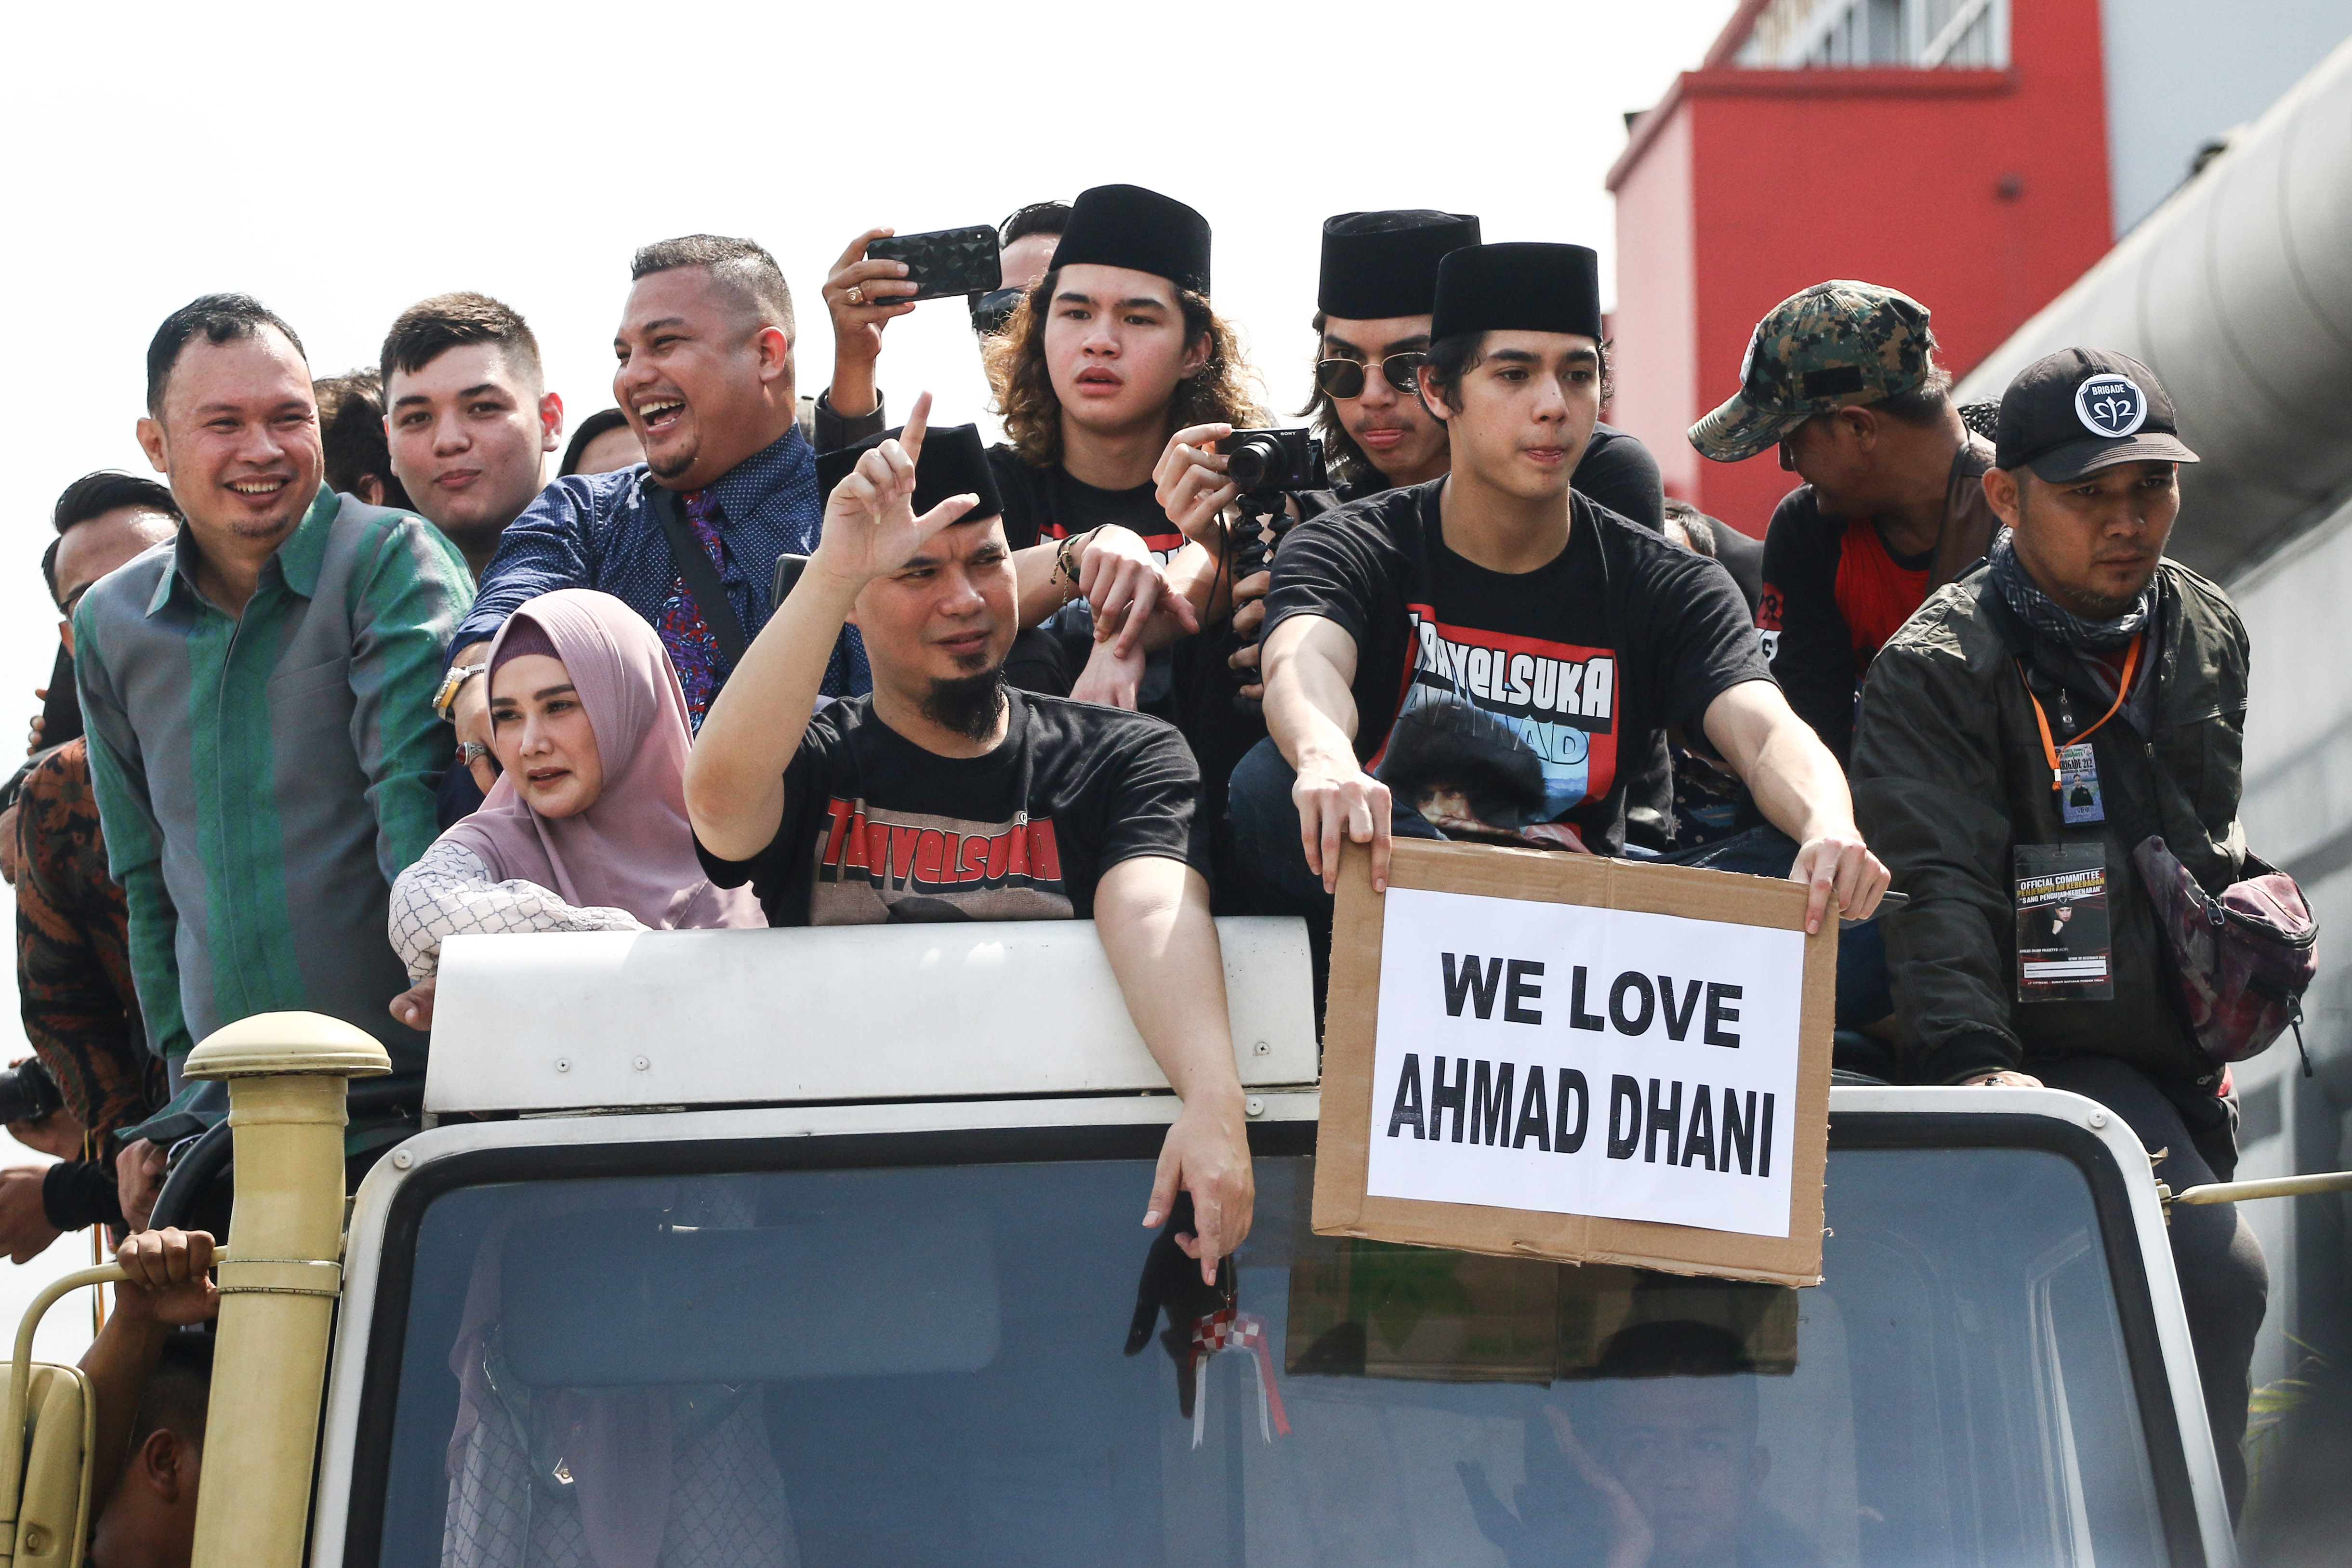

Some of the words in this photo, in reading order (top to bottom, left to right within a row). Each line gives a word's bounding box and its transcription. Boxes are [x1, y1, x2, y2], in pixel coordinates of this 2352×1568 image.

[2092, 384, 2125, 395] BRIGADE
[2082, 758, 2093, 768] 212
[2021, 878, 2054, 890] OFFICIAL
[2055, 870, 2100, 884] COMMITTEE
[2066, 878, 2105, 890] KEBEBASAN
[1441, 952, 1545, 1025] WE
[1570, 965, 1743, 1049] LOVE
[1387, 1053, 1589, 1154] AHMAD
[1607, 1074, 1775, 1178] DHANI
